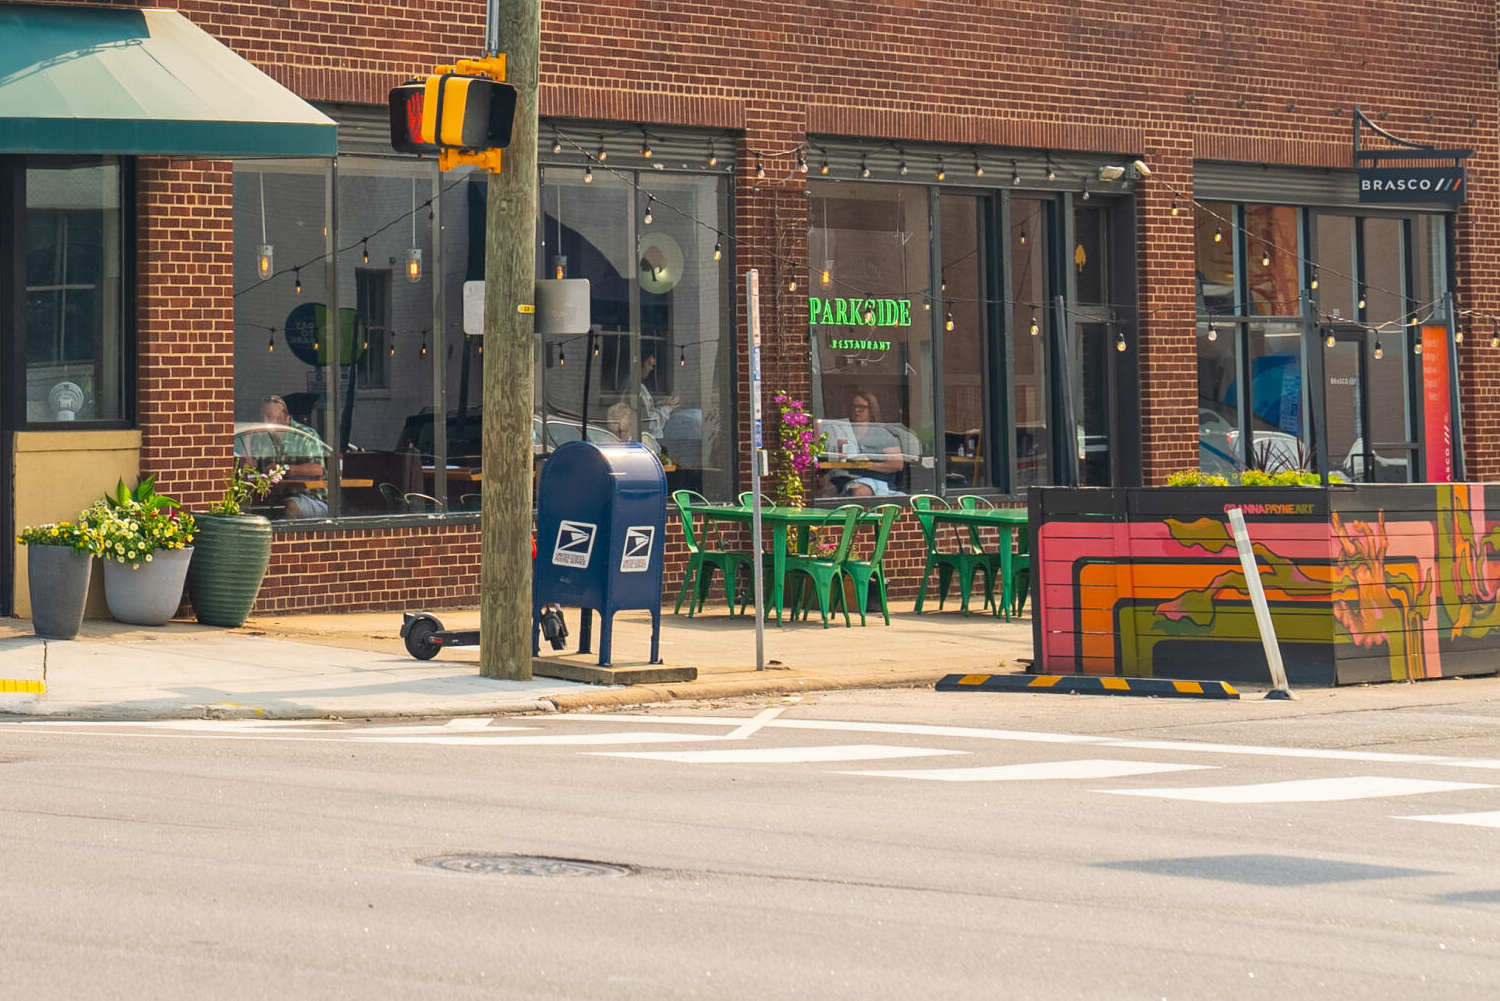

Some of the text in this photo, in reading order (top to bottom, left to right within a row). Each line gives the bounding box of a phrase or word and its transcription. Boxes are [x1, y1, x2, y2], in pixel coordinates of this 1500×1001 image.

[1361, 179, 1431, 191] BRASCO
[809, 297, 912, 327] PARKSIDE
[831, 339, 891, 351] RESTAURANT
